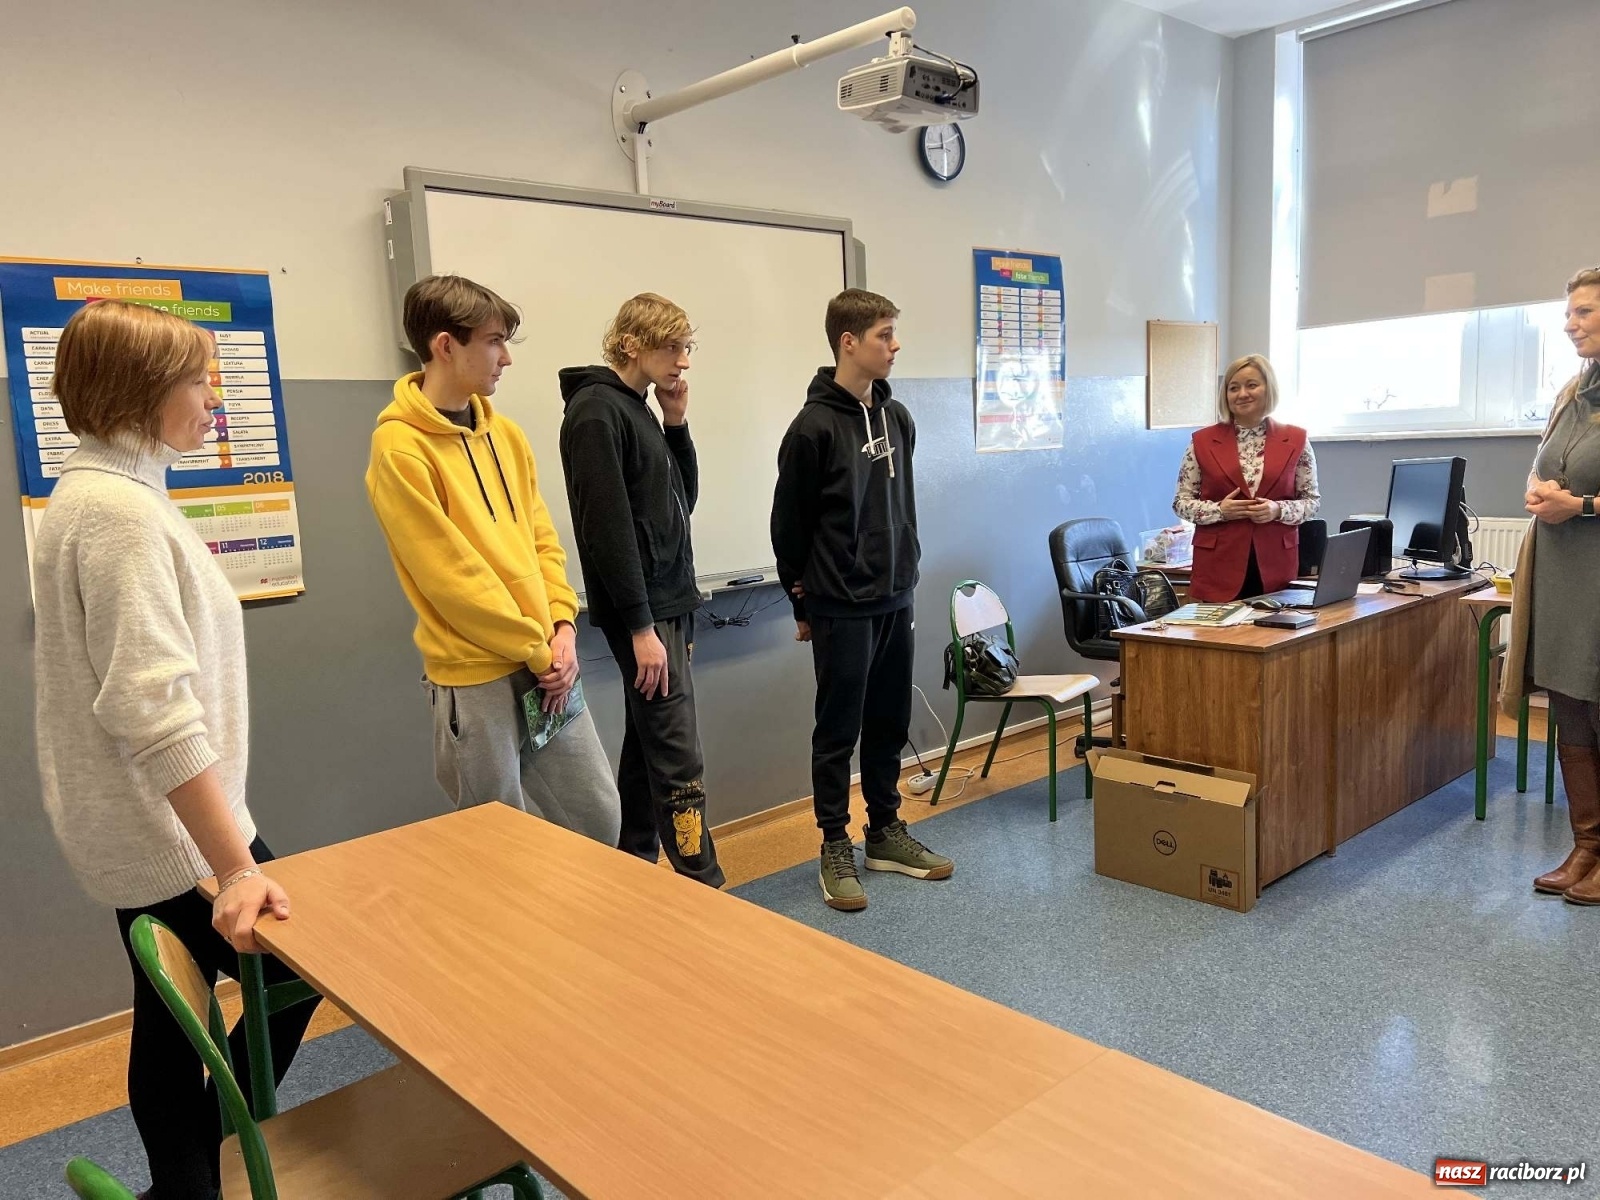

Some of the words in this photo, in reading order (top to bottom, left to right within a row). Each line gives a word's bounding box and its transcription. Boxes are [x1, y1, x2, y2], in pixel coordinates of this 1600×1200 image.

[651, 200, 675, 209] myBoard
[67, 281, 112, 296] Make
[116, 282, 172, 296] friends
[172, 303, 220, 317] friends
[243, 471, 285, 485] 2018
[259, 538, 268, 546] 12
[1156, 837, 1175, 848] DELL
